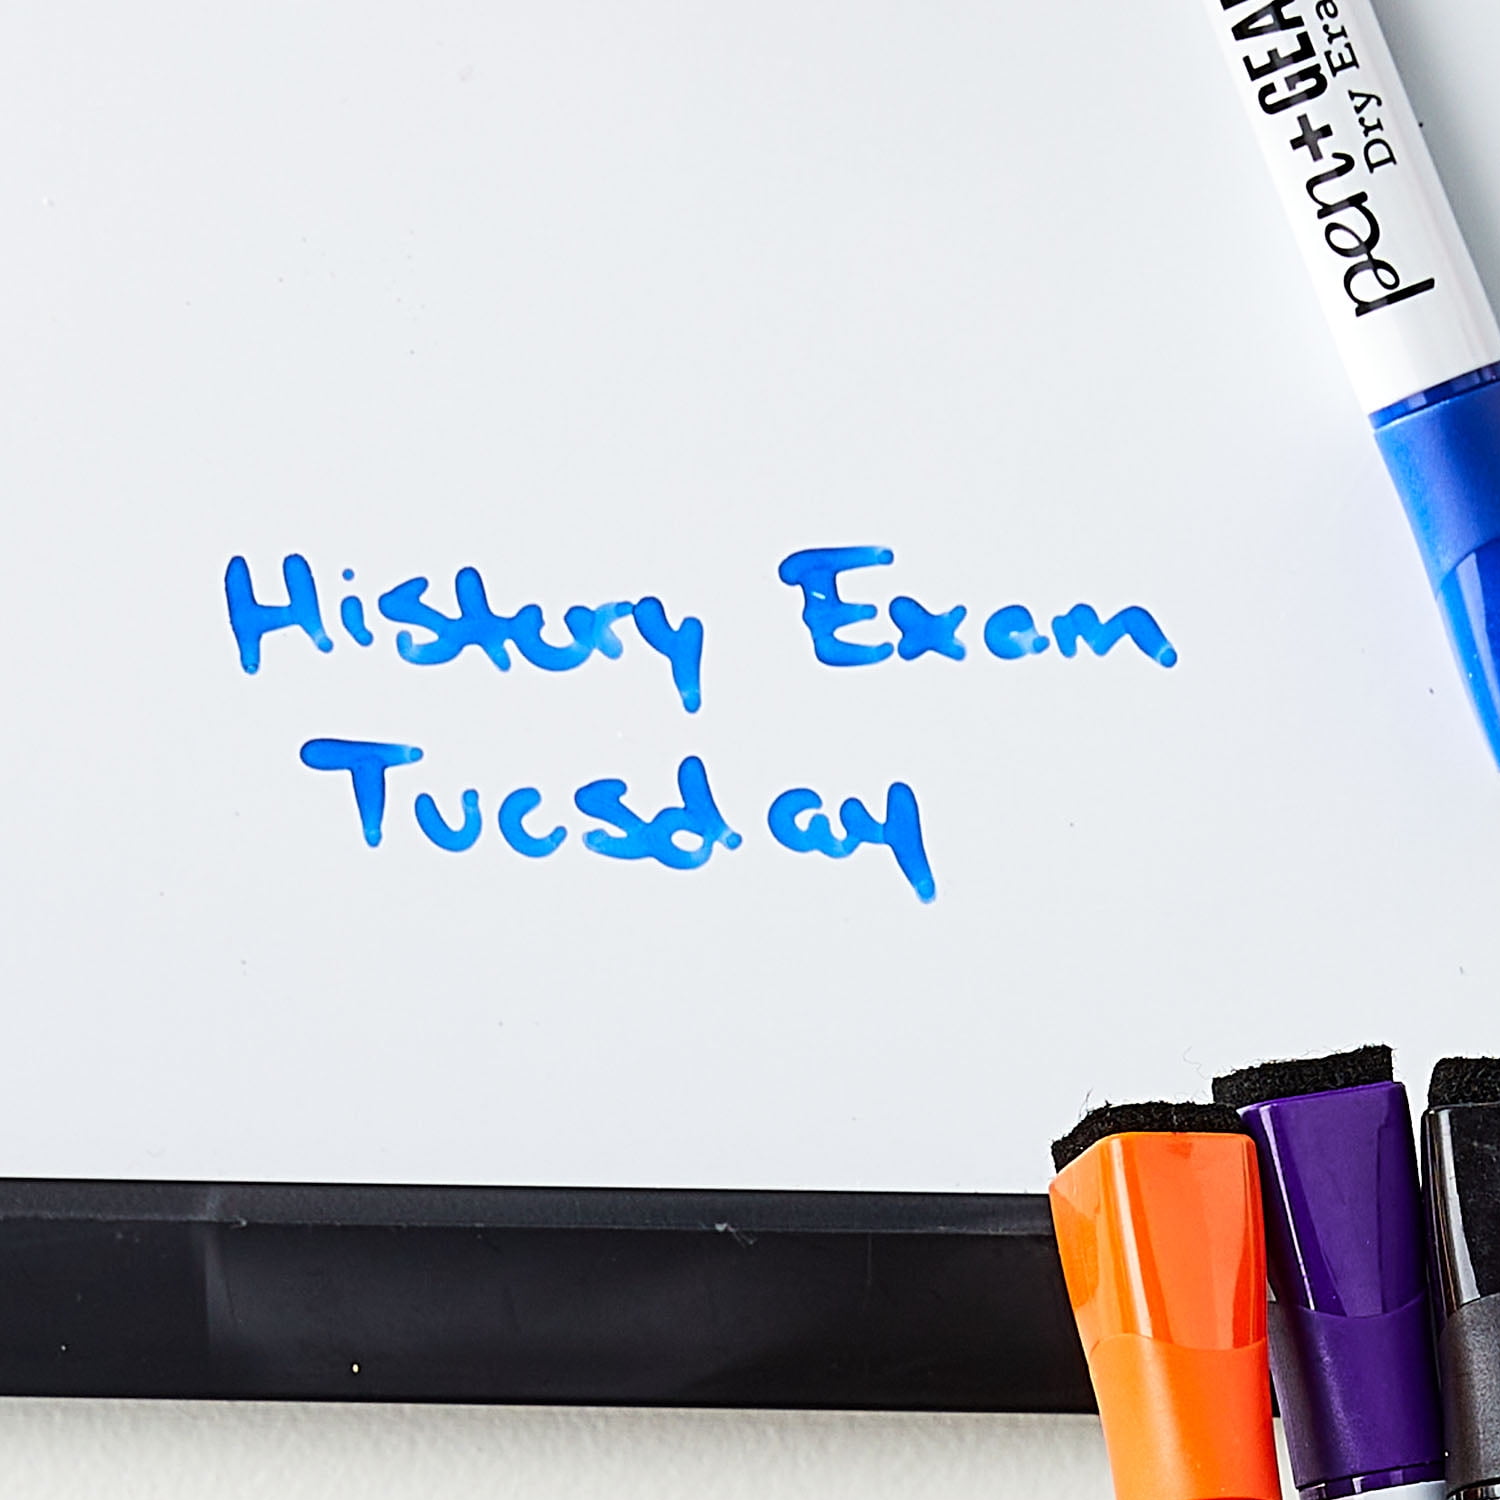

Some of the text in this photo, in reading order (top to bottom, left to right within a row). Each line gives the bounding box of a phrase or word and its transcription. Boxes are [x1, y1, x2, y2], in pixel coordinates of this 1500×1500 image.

[1220, 0, 1435, 317] pen+GEA
[1348, 90, 1398, 174] Dry
[224, 545, 1178, 712] History Exam
[299, 738, 936, 903] Tuesday
